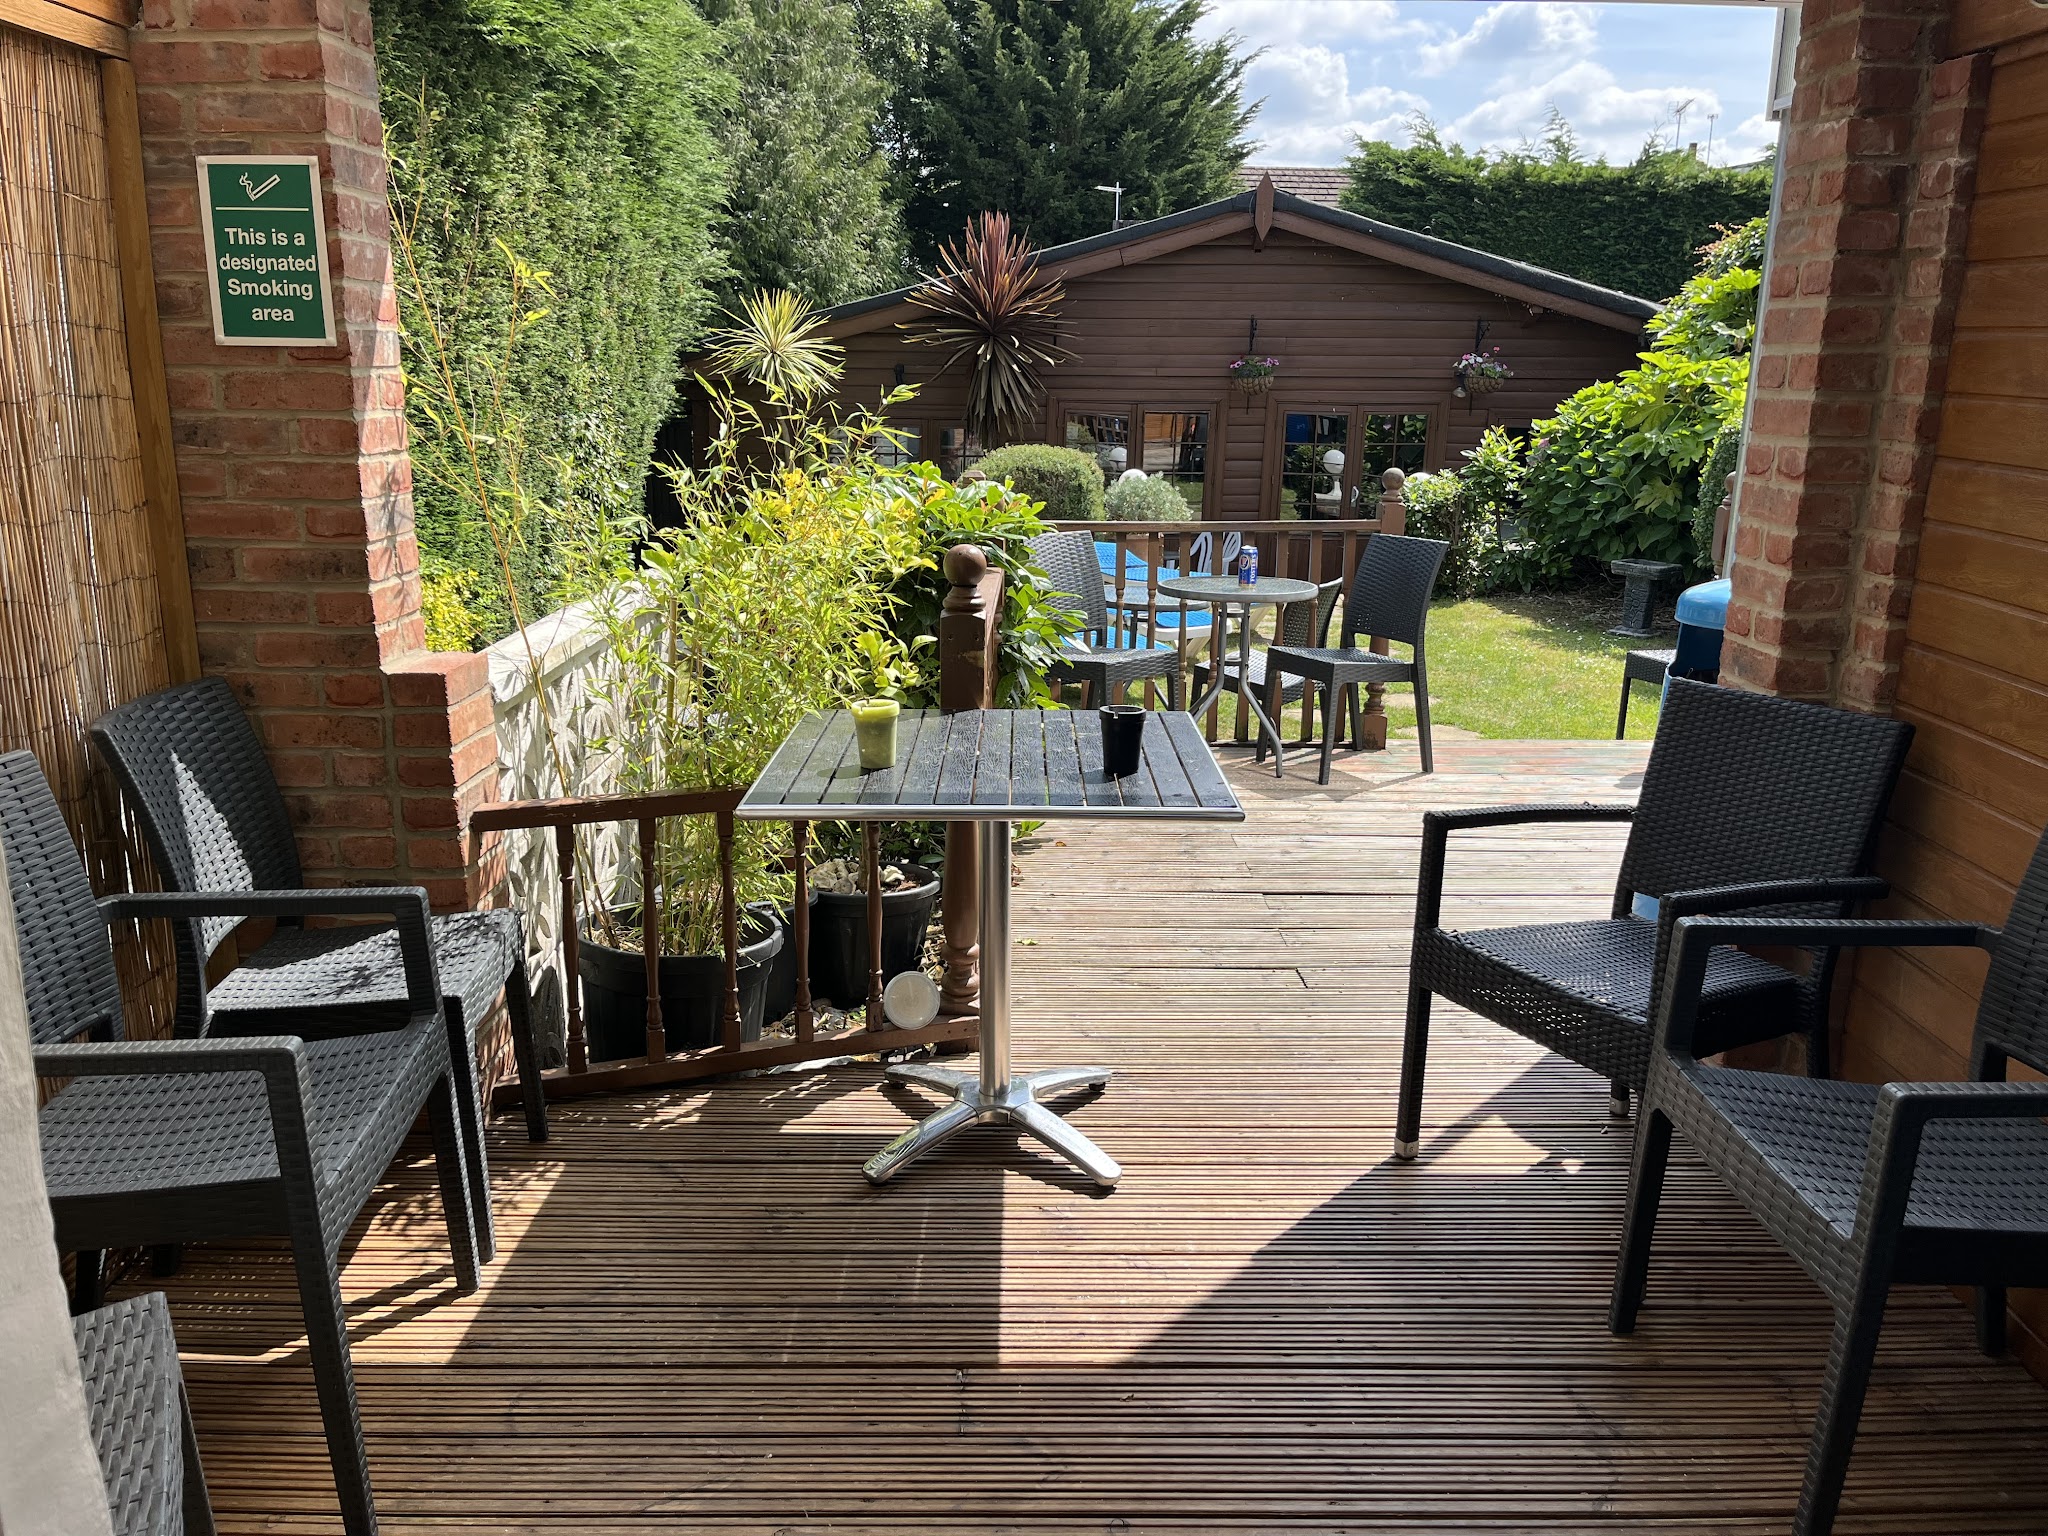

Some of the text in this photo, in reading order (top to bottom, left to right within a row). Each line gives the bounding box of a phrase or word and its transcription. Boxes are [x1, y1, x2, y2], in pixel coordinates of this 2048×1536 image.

[224, 228, 306, 246] This is a
[219, 253, 317, 275] designated
[227, 278, 314, 301] Smoking
[251, 307, 295, 322] area
